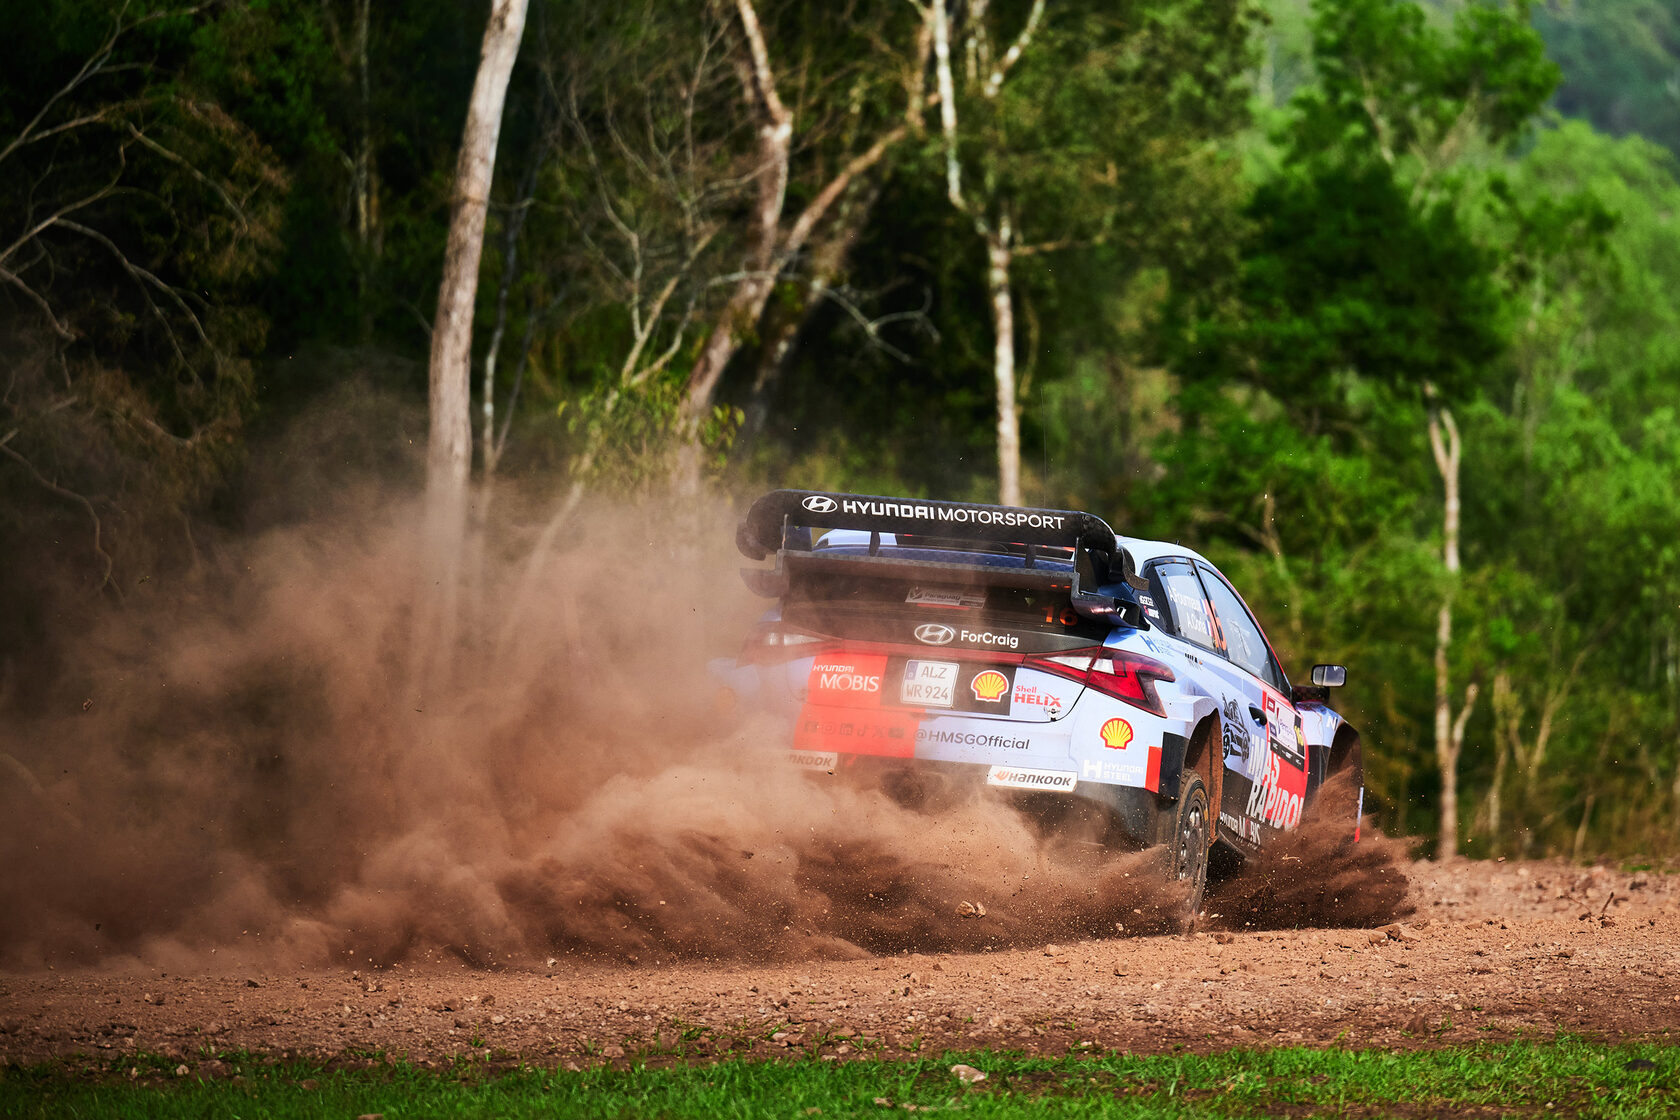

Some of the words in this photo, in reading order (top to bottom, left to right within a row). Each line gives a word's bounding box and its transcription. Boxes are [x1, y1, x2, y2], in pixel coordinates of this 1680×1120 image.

[843, 500, 935, 520] HYUNDAI
[938, 508, 1065, 529] MOTORSPORT
[1042, 605, 1078, 626] 16
[960, 630, 1019, 648] ForCraig
[813, 664, 854, 673] HYUNDAI
[921, 666, 947, 680] ALZ
[820, 674, 879, 692] MOBIS
[1015, 685, 1037, 693] Shell
[906, 684, 922, 697] WR
[925, 687, 949, 700] 924
[1014, 692, 1062, 708] HELIX
[914, 728, 1031, 750] @HMSGOfficial
[1104, 772, 1132, 782] STEEL
